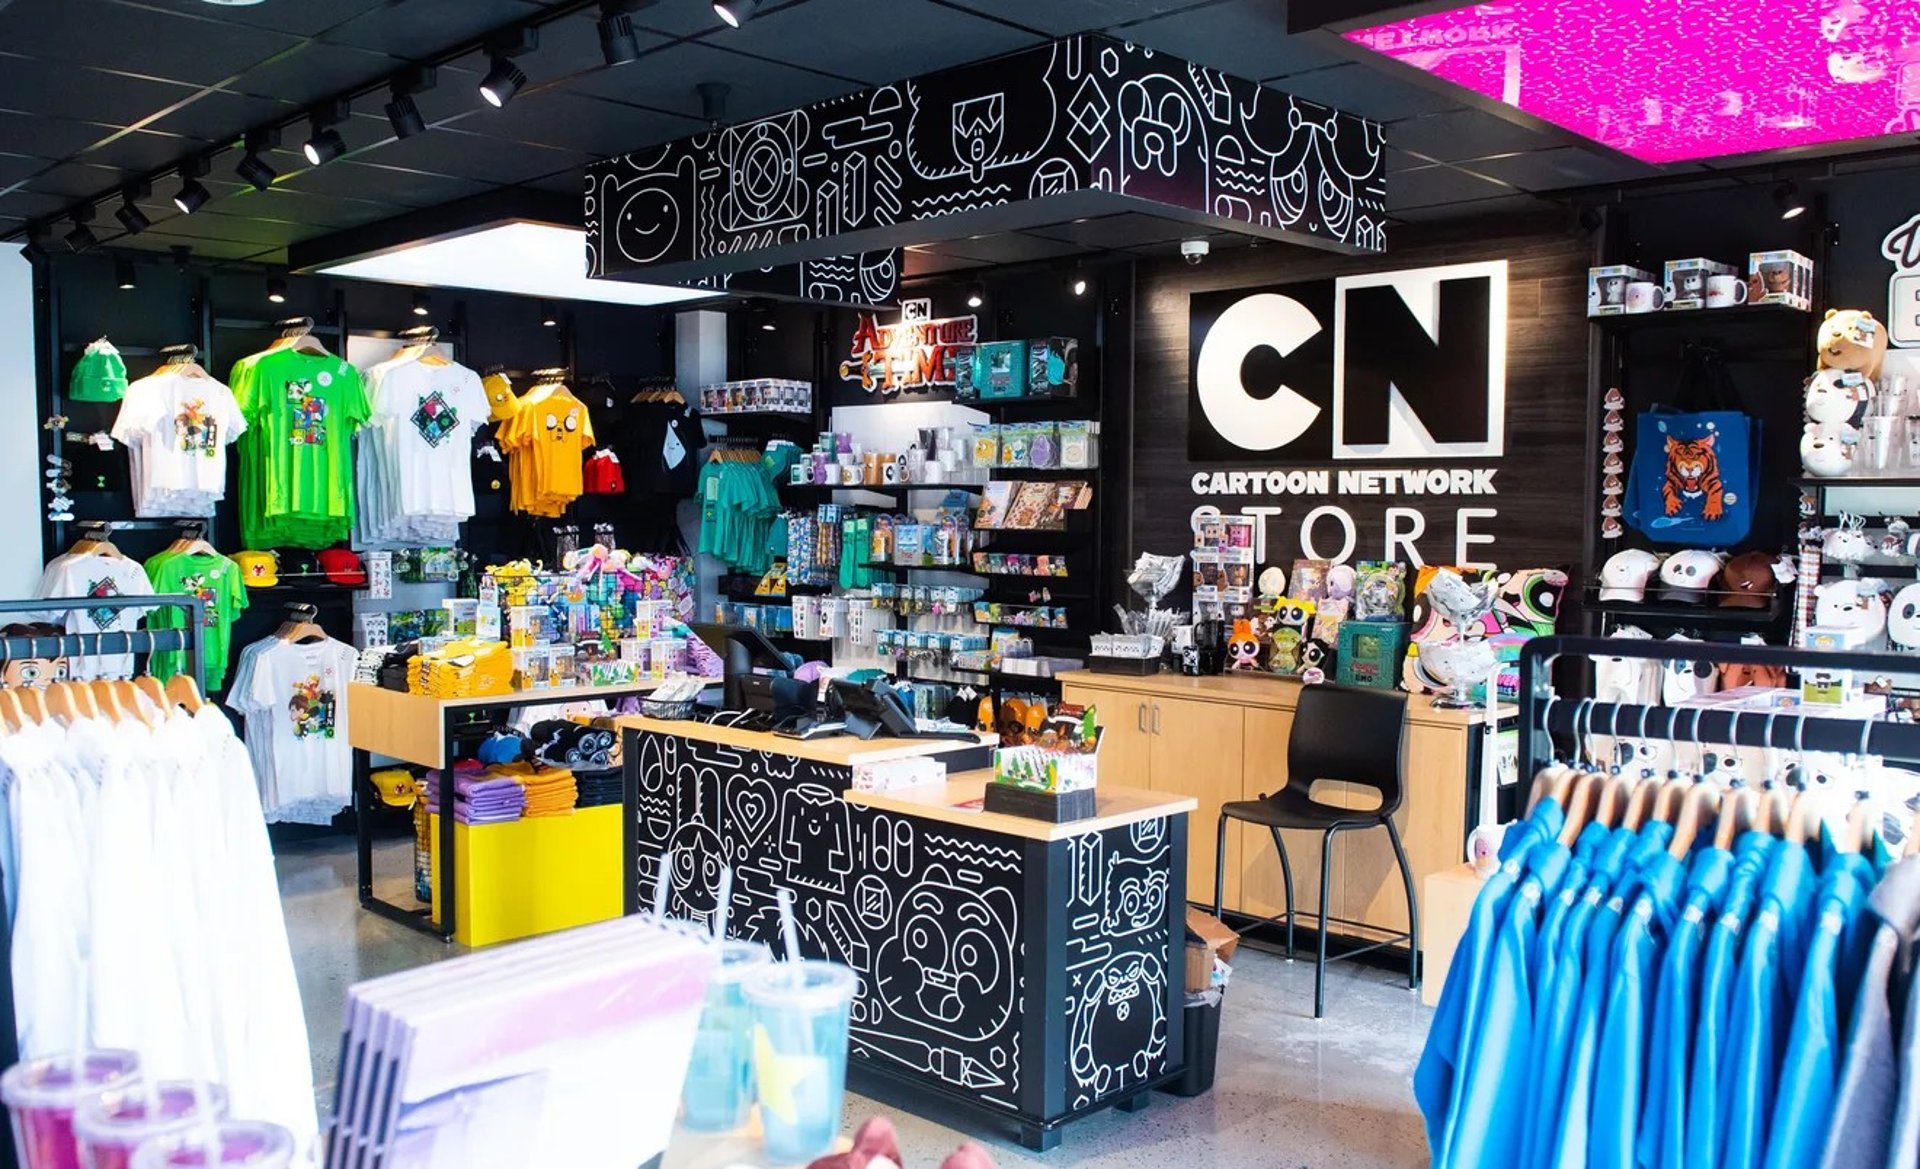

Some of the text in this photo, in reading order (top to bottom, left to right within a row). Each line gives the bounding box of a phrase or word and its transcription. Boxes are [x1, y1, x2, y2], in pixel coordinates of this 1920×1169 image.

[905, 302, 928, 320] CN
[1196, 274, 1492, 452] CN
[1191, 469, 1499, 495] CARTOON NETWORK
